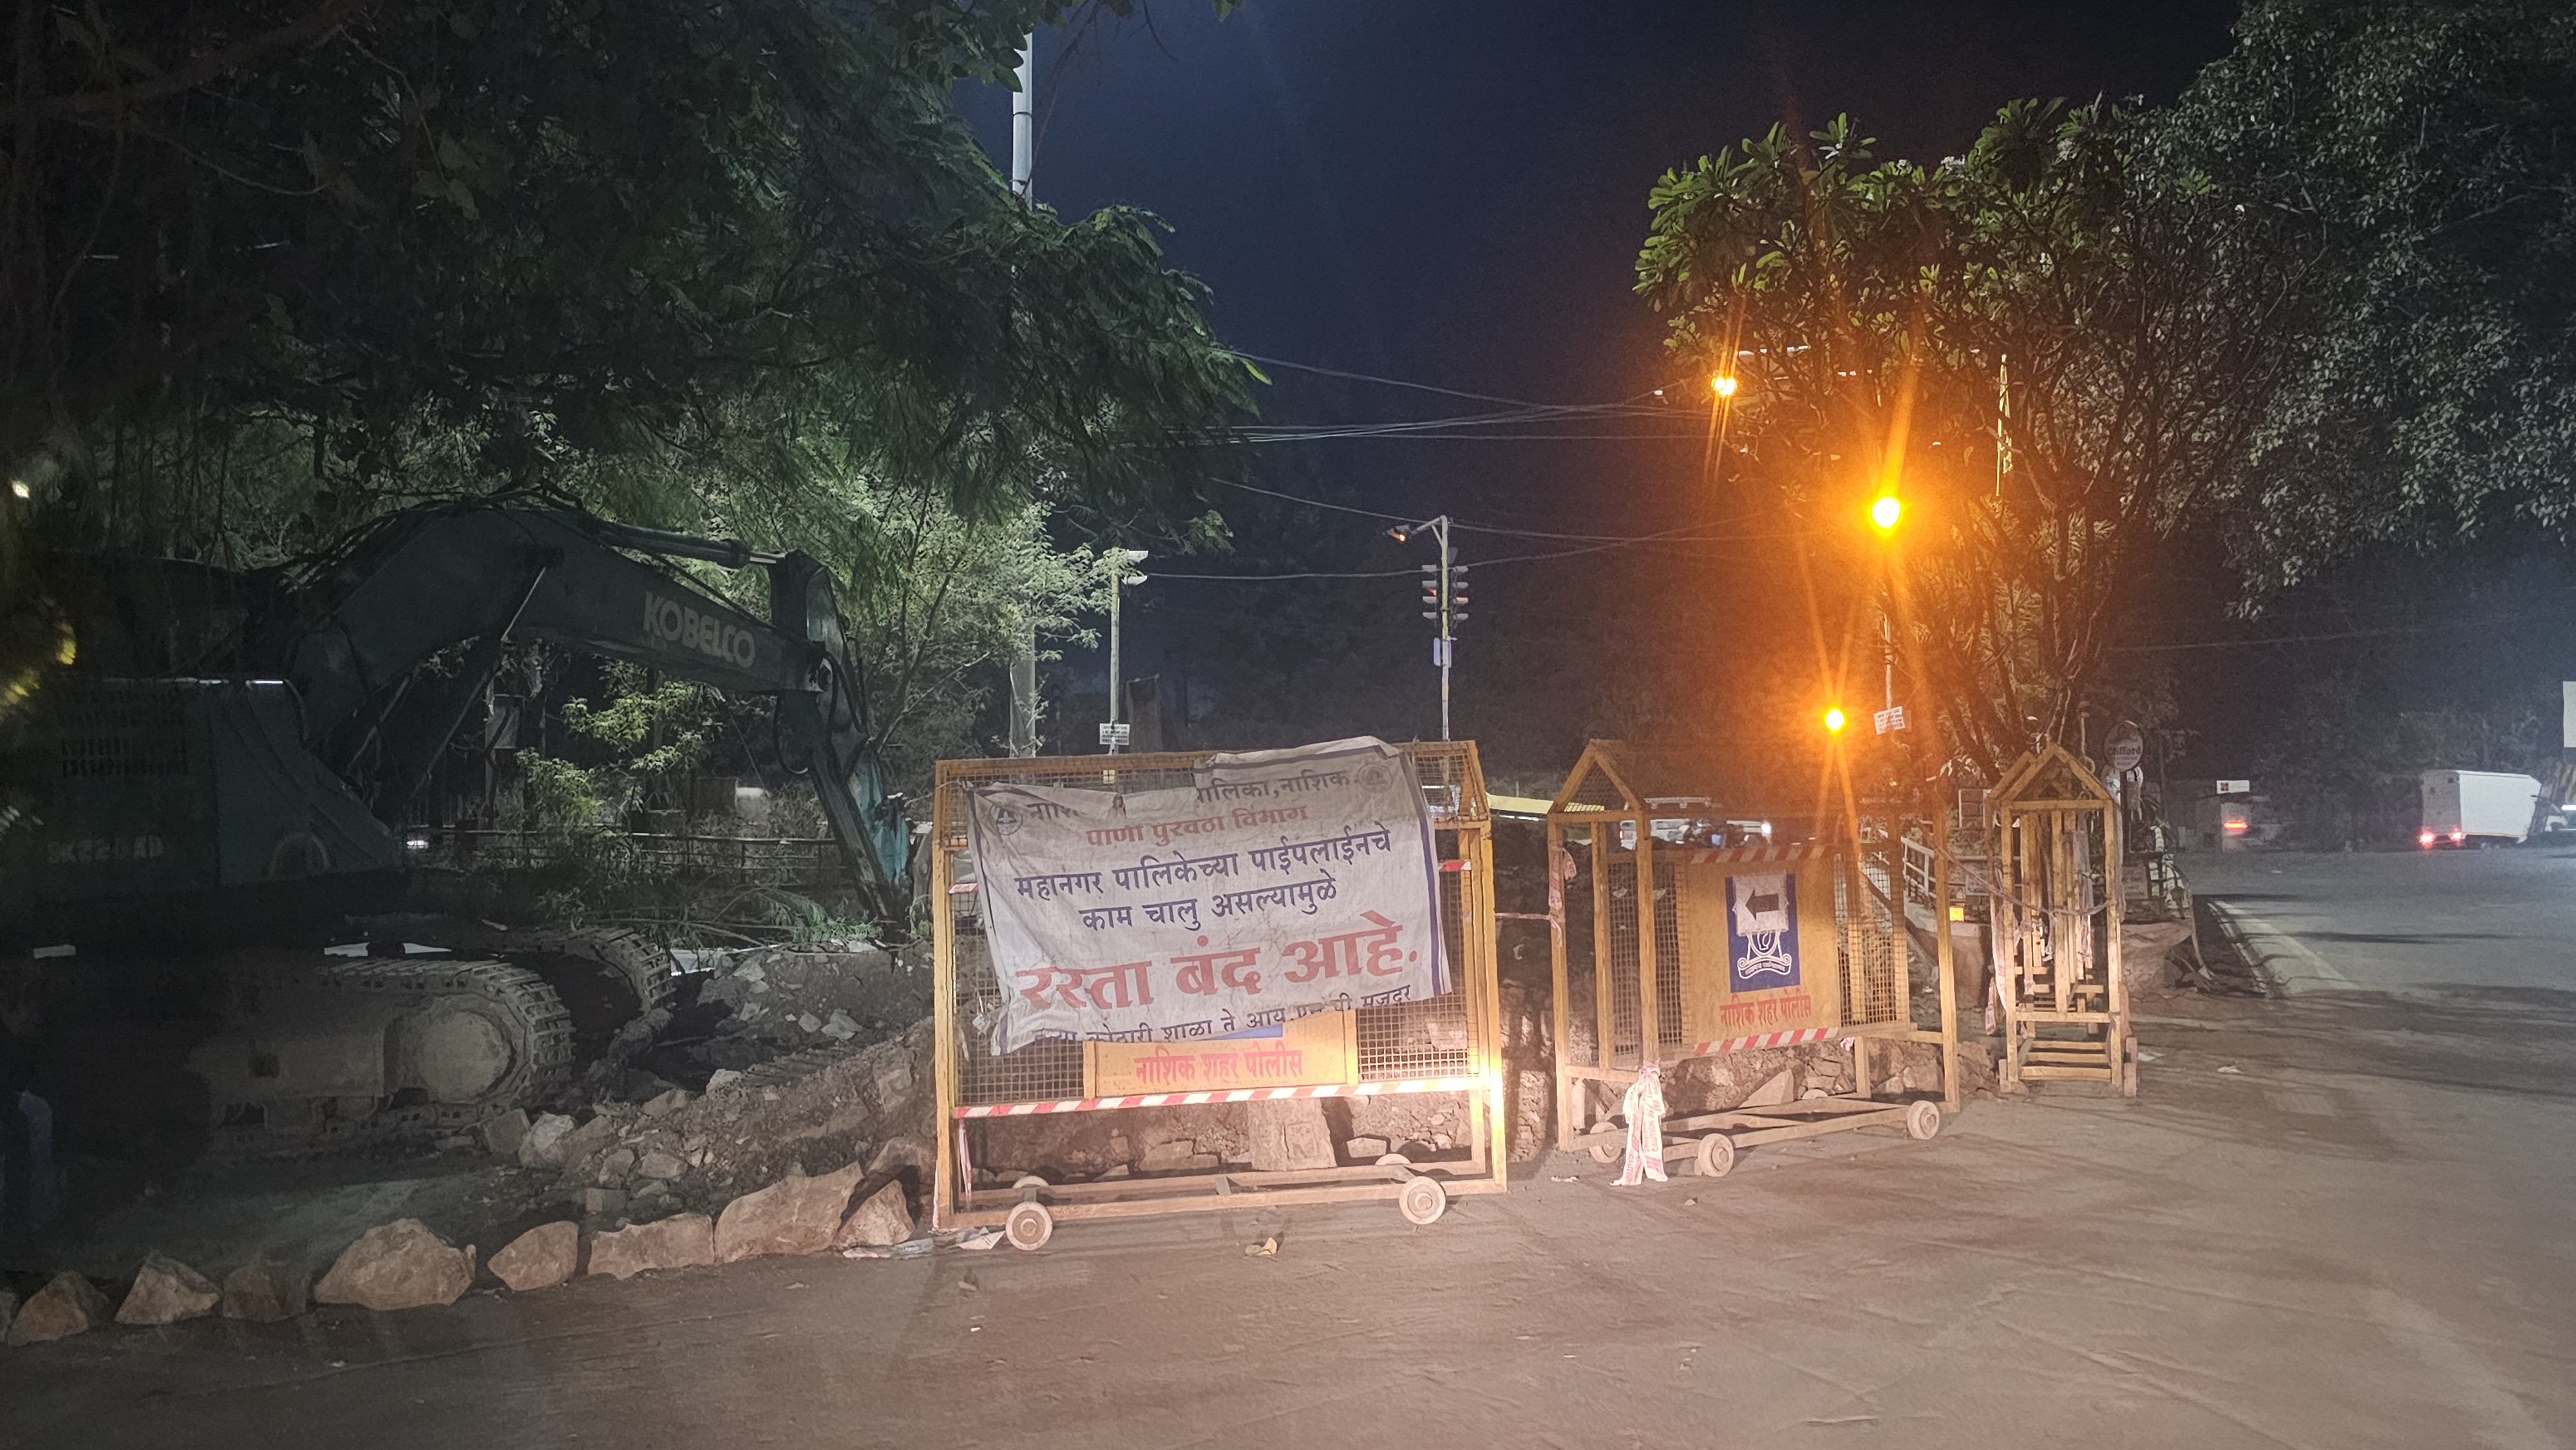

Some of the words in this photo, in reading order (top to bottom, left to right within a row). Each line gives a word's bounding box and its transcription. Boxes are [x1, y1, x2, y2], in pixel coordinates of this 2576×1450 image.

[643, 590, 755, 668] KOBELCO
[1151, 816, 1226, 847] पुरवठा
[1231, 805, 1308, 829] विभाग
[1014, 871, 1104, 901] महानगर
[1112, 850, 1239, 891] पालिकेच्या
[1247, 820, 1391, 876] पाईपलाईनचे
[1078, 905, 1133, 931] काम
[1142, 898, 1201, 932] चालु
[1211, 869, 1337, 918] असल्यामुळे
[1015, 960, 1155, 1010] रस्ता
[1170, 934, 1262, 997] बंद
[1281, 909, 1418, 983] आहे.
[1160, 1019, 1213, 1040] शाळा
[1220, 1008, 1236, 1031] ते
[1719, 993, 1755, 1030] नाशिक
[1756, 998, 1778, 1026] शहर
[1779, 986, 1812, 1019] पोलीस
[1133, 1044, 1196, 1086] नाशिक
[1200, 1052, 1239, 1084] शहर
[1244, 1039, 1303, 1078] पोलीस
